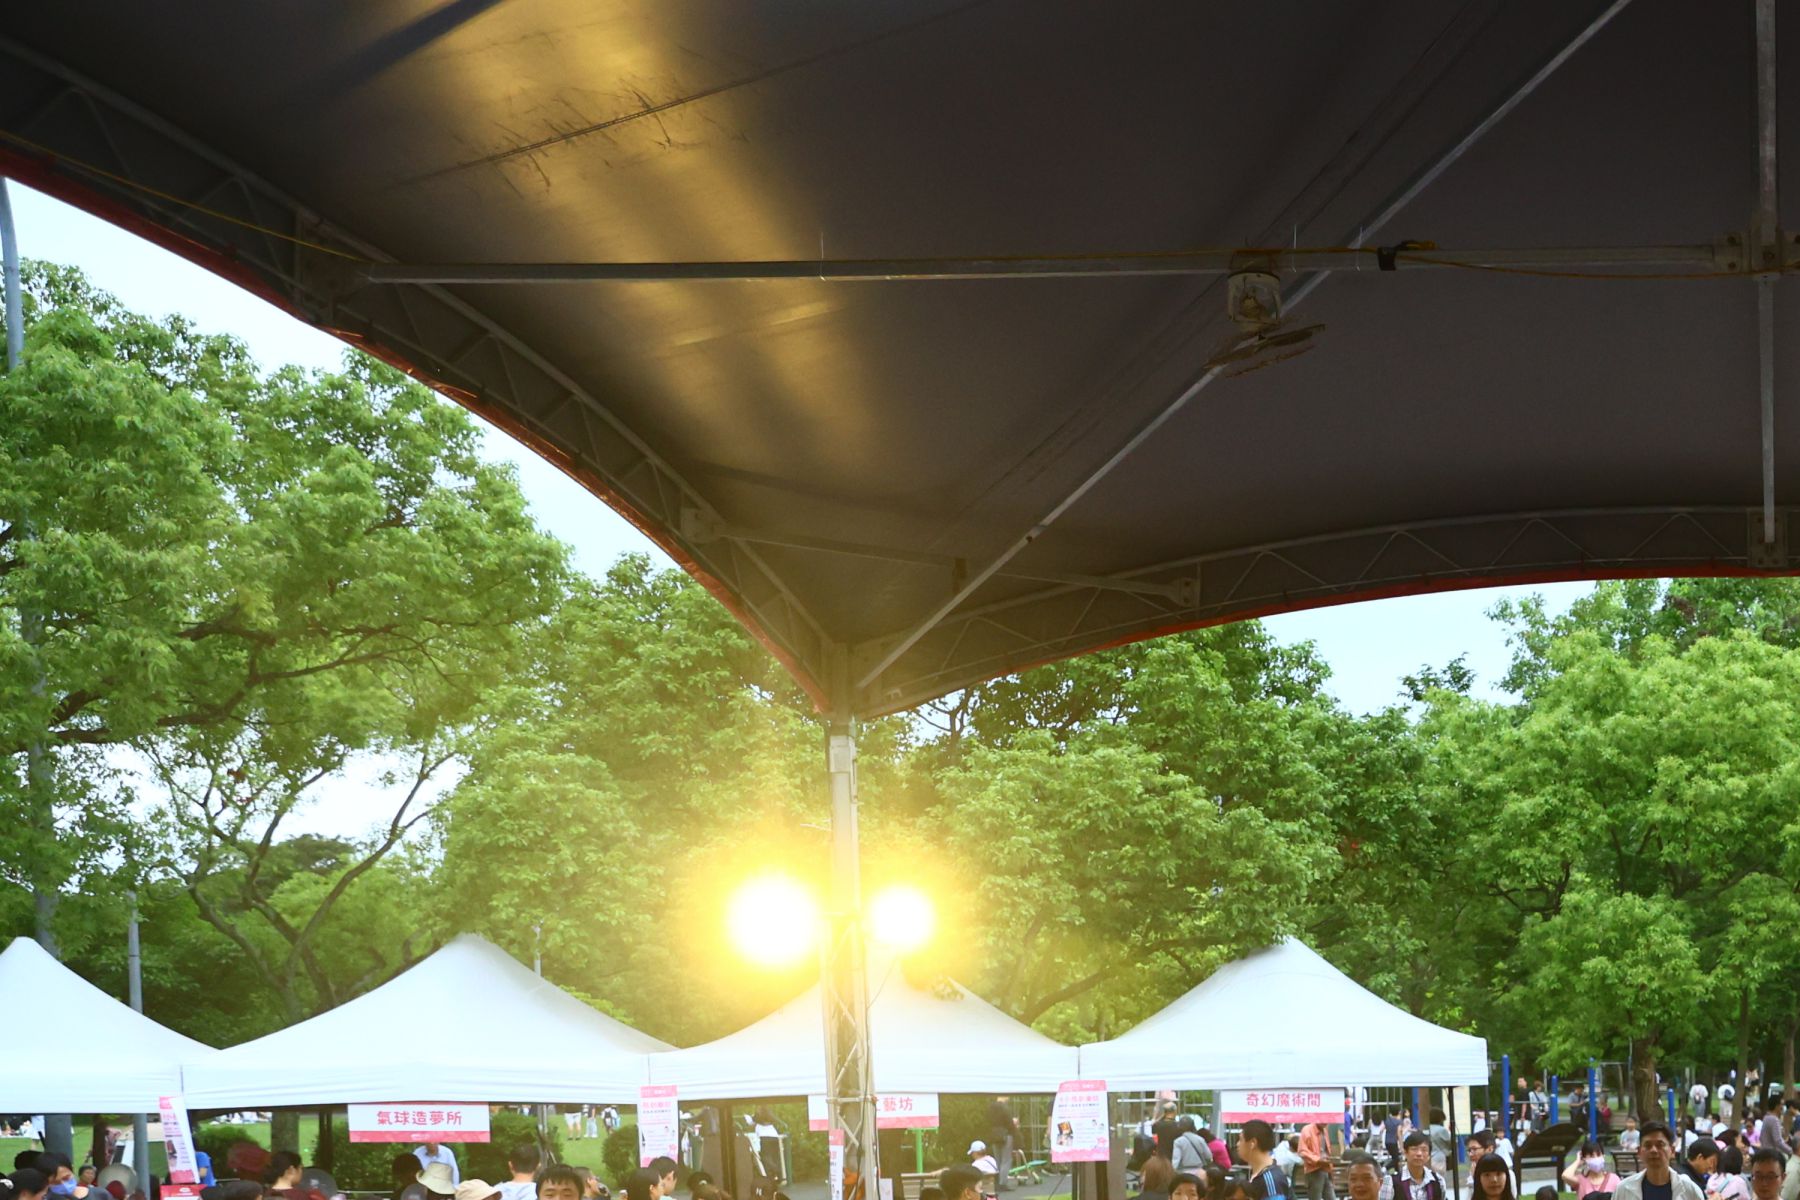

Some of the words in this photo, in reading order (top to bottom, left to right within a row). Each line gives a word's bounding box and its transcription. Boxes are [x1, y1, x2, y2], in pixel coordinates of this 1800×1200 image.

[876, 1096, 913, 1111] 藝坊
[1246, 1093, 1321, 1107] 奇幻魔術間
[377, 1111, 462, 1125] 氣球造夢所
